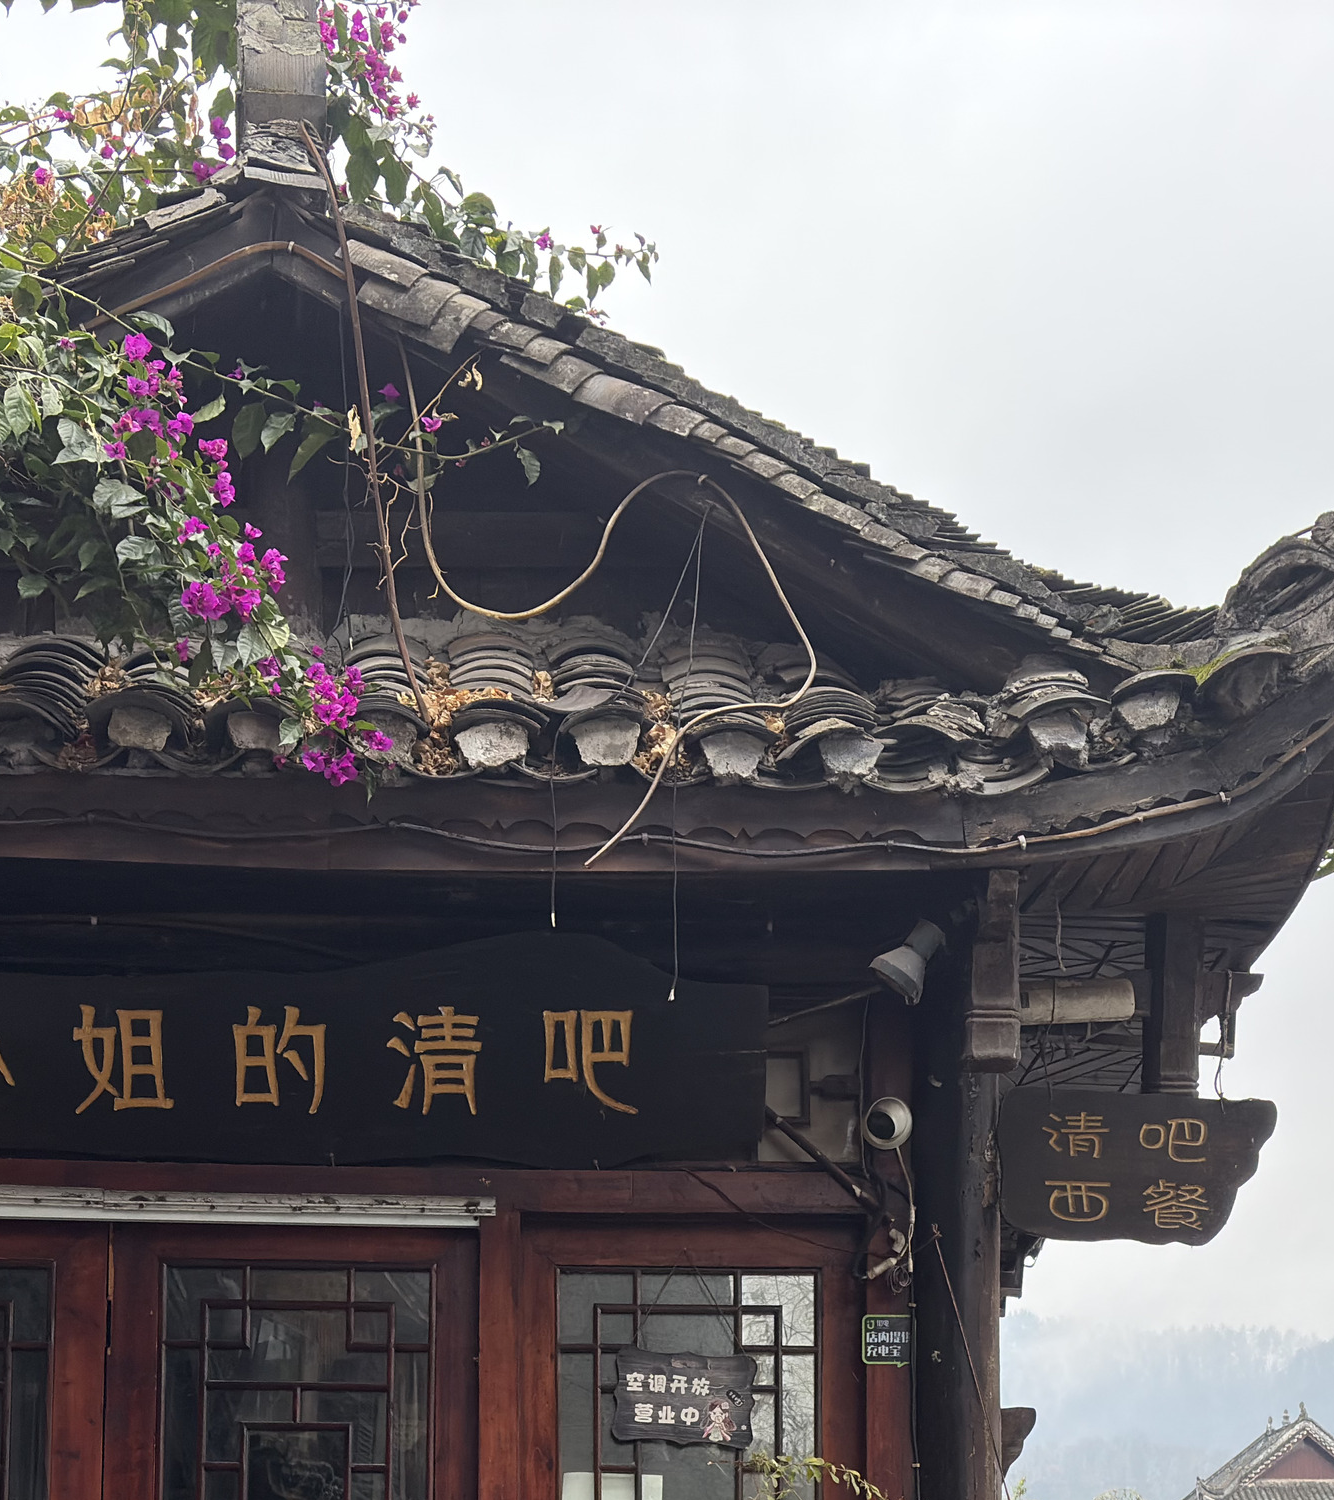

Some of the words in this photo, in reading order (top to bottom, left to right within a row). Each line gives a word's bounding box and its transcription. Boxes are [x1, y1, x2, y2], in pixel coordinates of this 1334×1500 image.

[1042, 1112, 1208, 1163] 清吧
[1044, 1179, 1210, 1230] 西餐
[866, 1345, 901, 1357] 充电宝
[625, 1372, 712, 1397] 空调开放
[633, 1402, 700, 1427] 营业中
